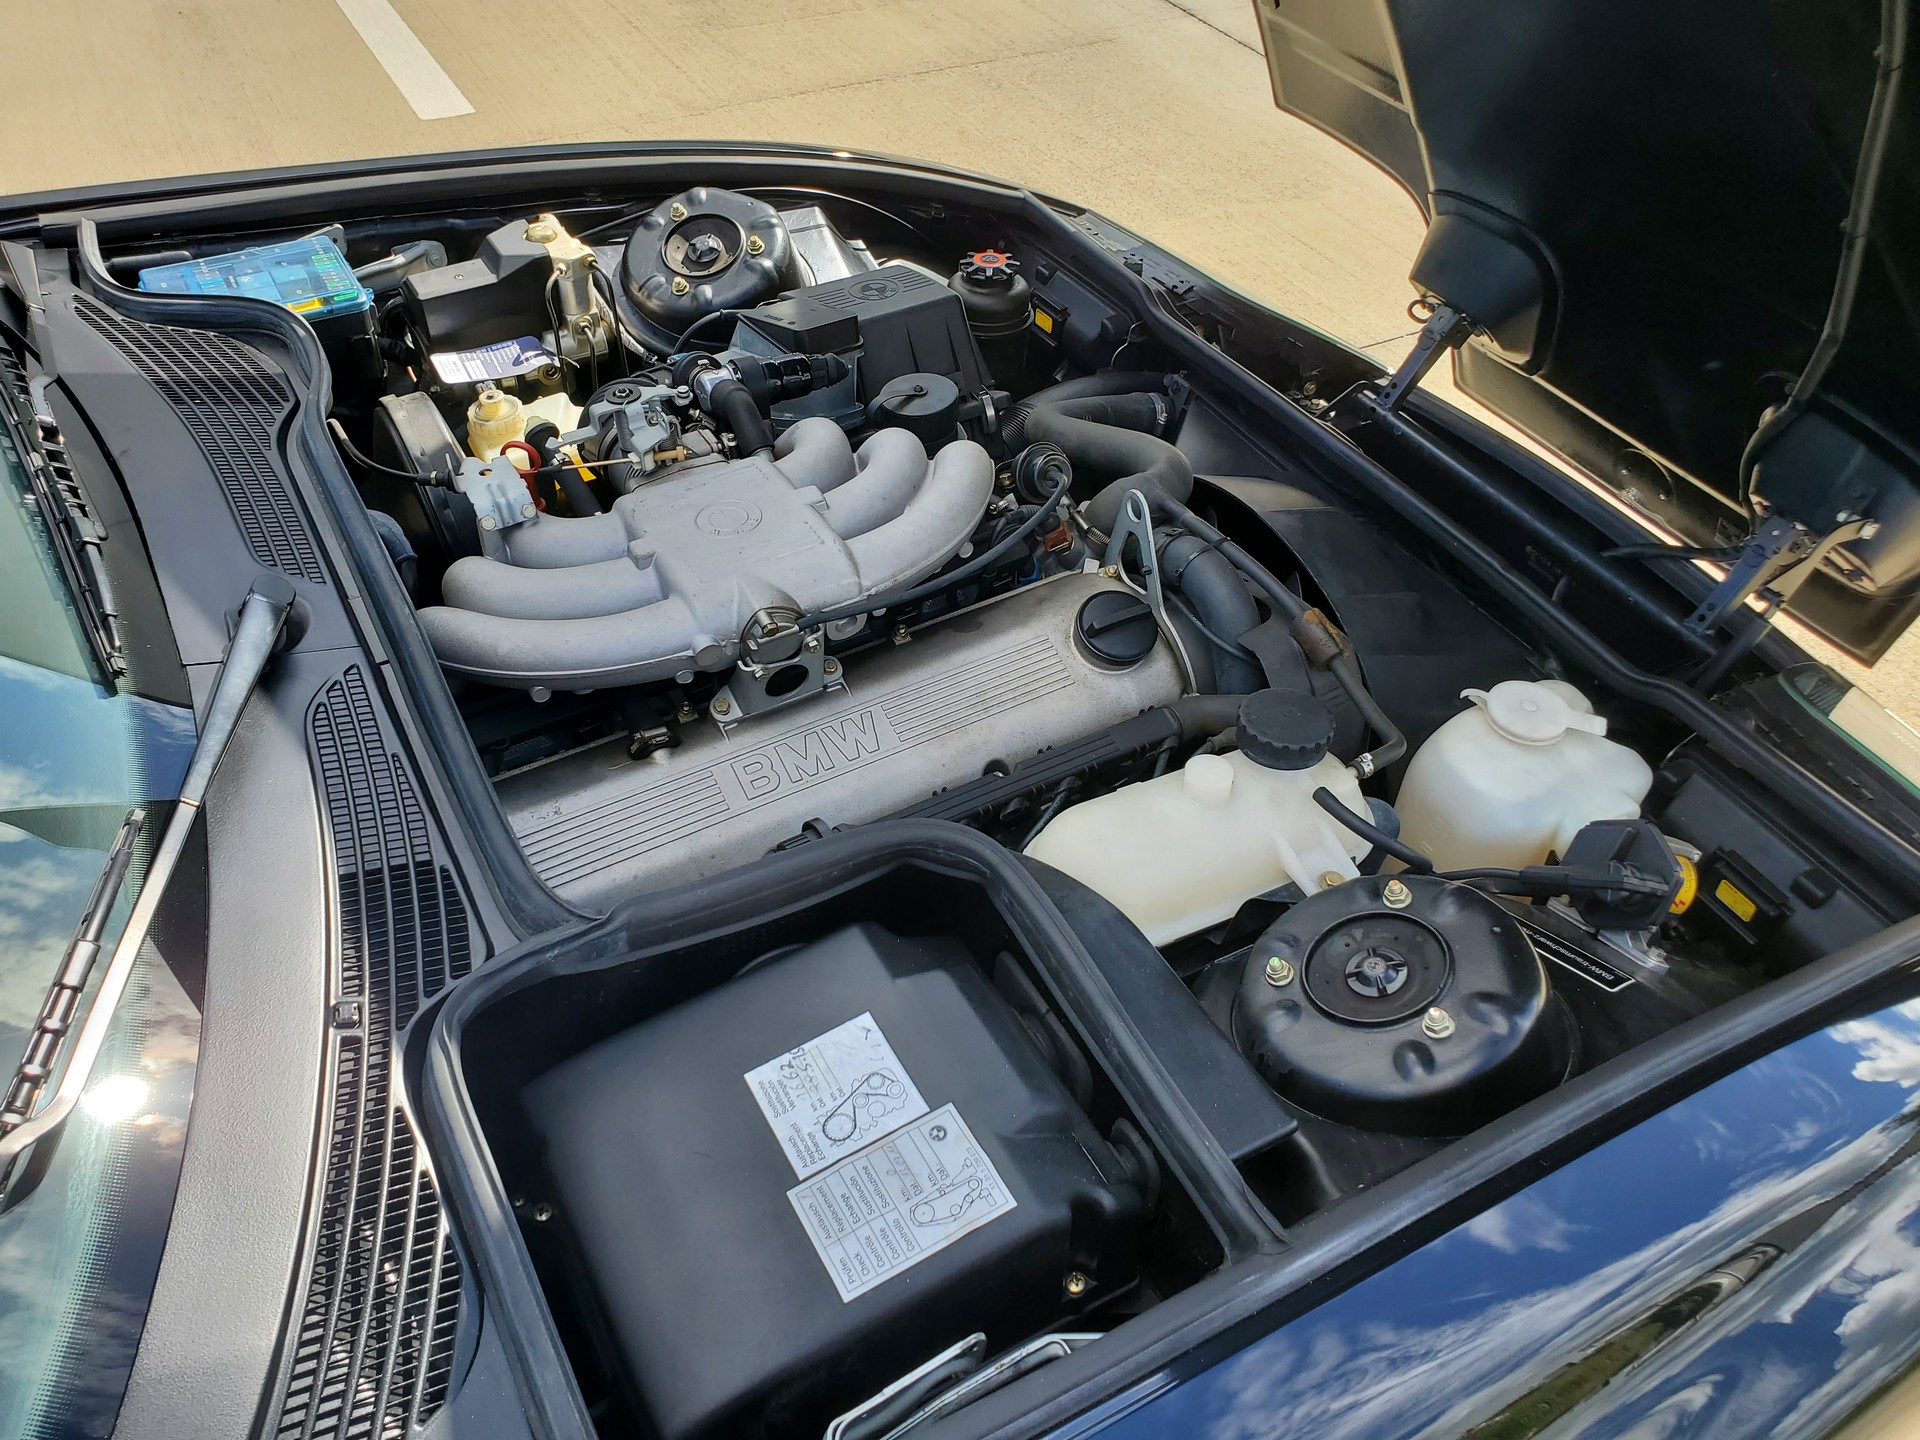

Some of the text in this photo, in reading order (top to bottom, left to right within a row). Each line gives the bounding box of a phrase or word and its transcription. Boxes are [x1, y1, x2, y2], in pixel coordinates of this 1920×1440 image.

[730, 710, 880, 801] BMW
[758, 1080, 782, 1119] Sostituzione
[787, 1134, 810, 1168] Austausch
[790, 1122, 818, 1165] Replacement
[806, 1131, 826, 1161] Echange
[862, 1165, 890, 1209] Sostituzione
[808, 1201, 832, 1240] Austausch
[816, 1185, 846, 1233] Replacement
[840, 1192, 861, 1225] Echange
[864, 1235, 886, 1268] Contrôle
[879, 1227, 901, 1260] Contrôle
[892, 1218, 915, 1252] Controllo
[839, 1256, 857, 1285] Prüfen
[853, 1250, 871, 1277] Check
